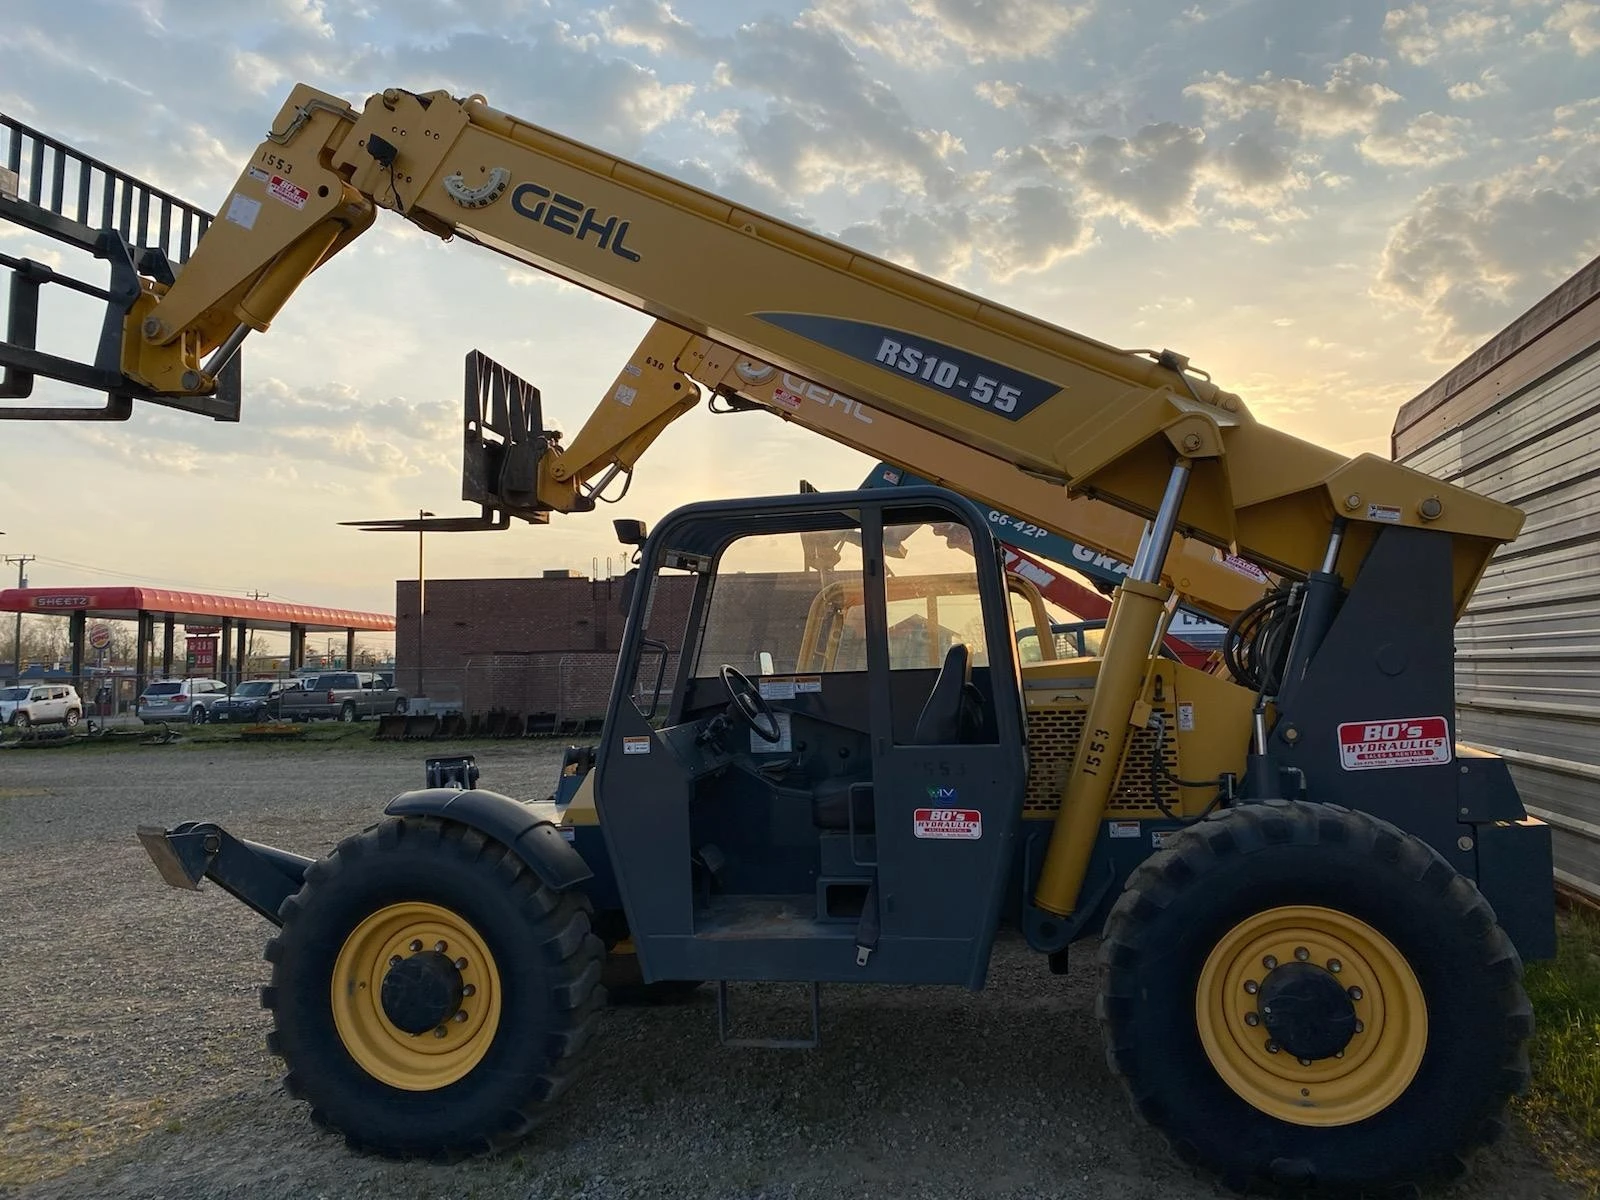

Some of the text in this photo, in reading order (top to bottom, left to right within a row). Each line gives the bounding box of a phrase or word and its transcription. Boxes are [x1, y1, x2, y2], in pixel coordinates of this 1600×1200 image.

[262, 152, 292, 174] 1553
[511, 183, 641, 263] GEHL
[646, 356, 664, 370] 630
[876, 338, 1022, 413] RS10-55
[988, 510, 1048, 538] G6-42P
[38, 597, 87, 606] SHEETZ
[1364, 723, 1423, 741] BO's
[1083, 729, 1109, 776] 1553
[1347, 739, 1442, 753] HYDRAULICS
[1364, 751, 1386, 759] SALES
[1395, 750, 1427, 758] RENTALS
[930, 811, 966, 821] BO's
